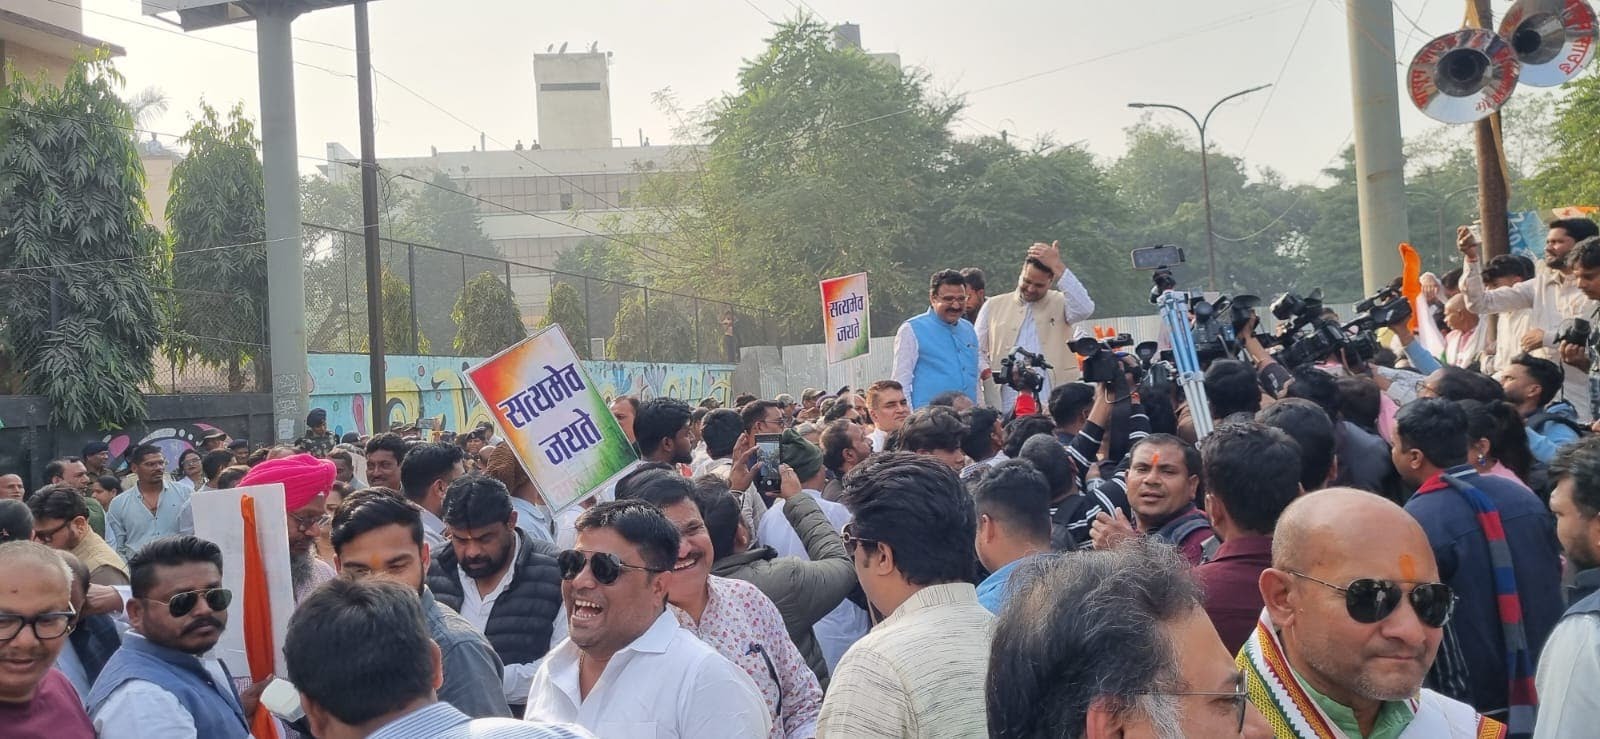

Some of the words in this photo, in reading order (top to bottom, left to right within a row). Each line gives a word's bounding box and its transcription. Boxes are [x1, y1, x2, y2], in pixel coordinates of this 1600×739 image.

[829, 292, 864, 318] सत्यमेव
[836, 318, 860, 342] जयते
[499, 363, 586, 429] सत्यमेव
[538, 408, 602, 465] जयते
